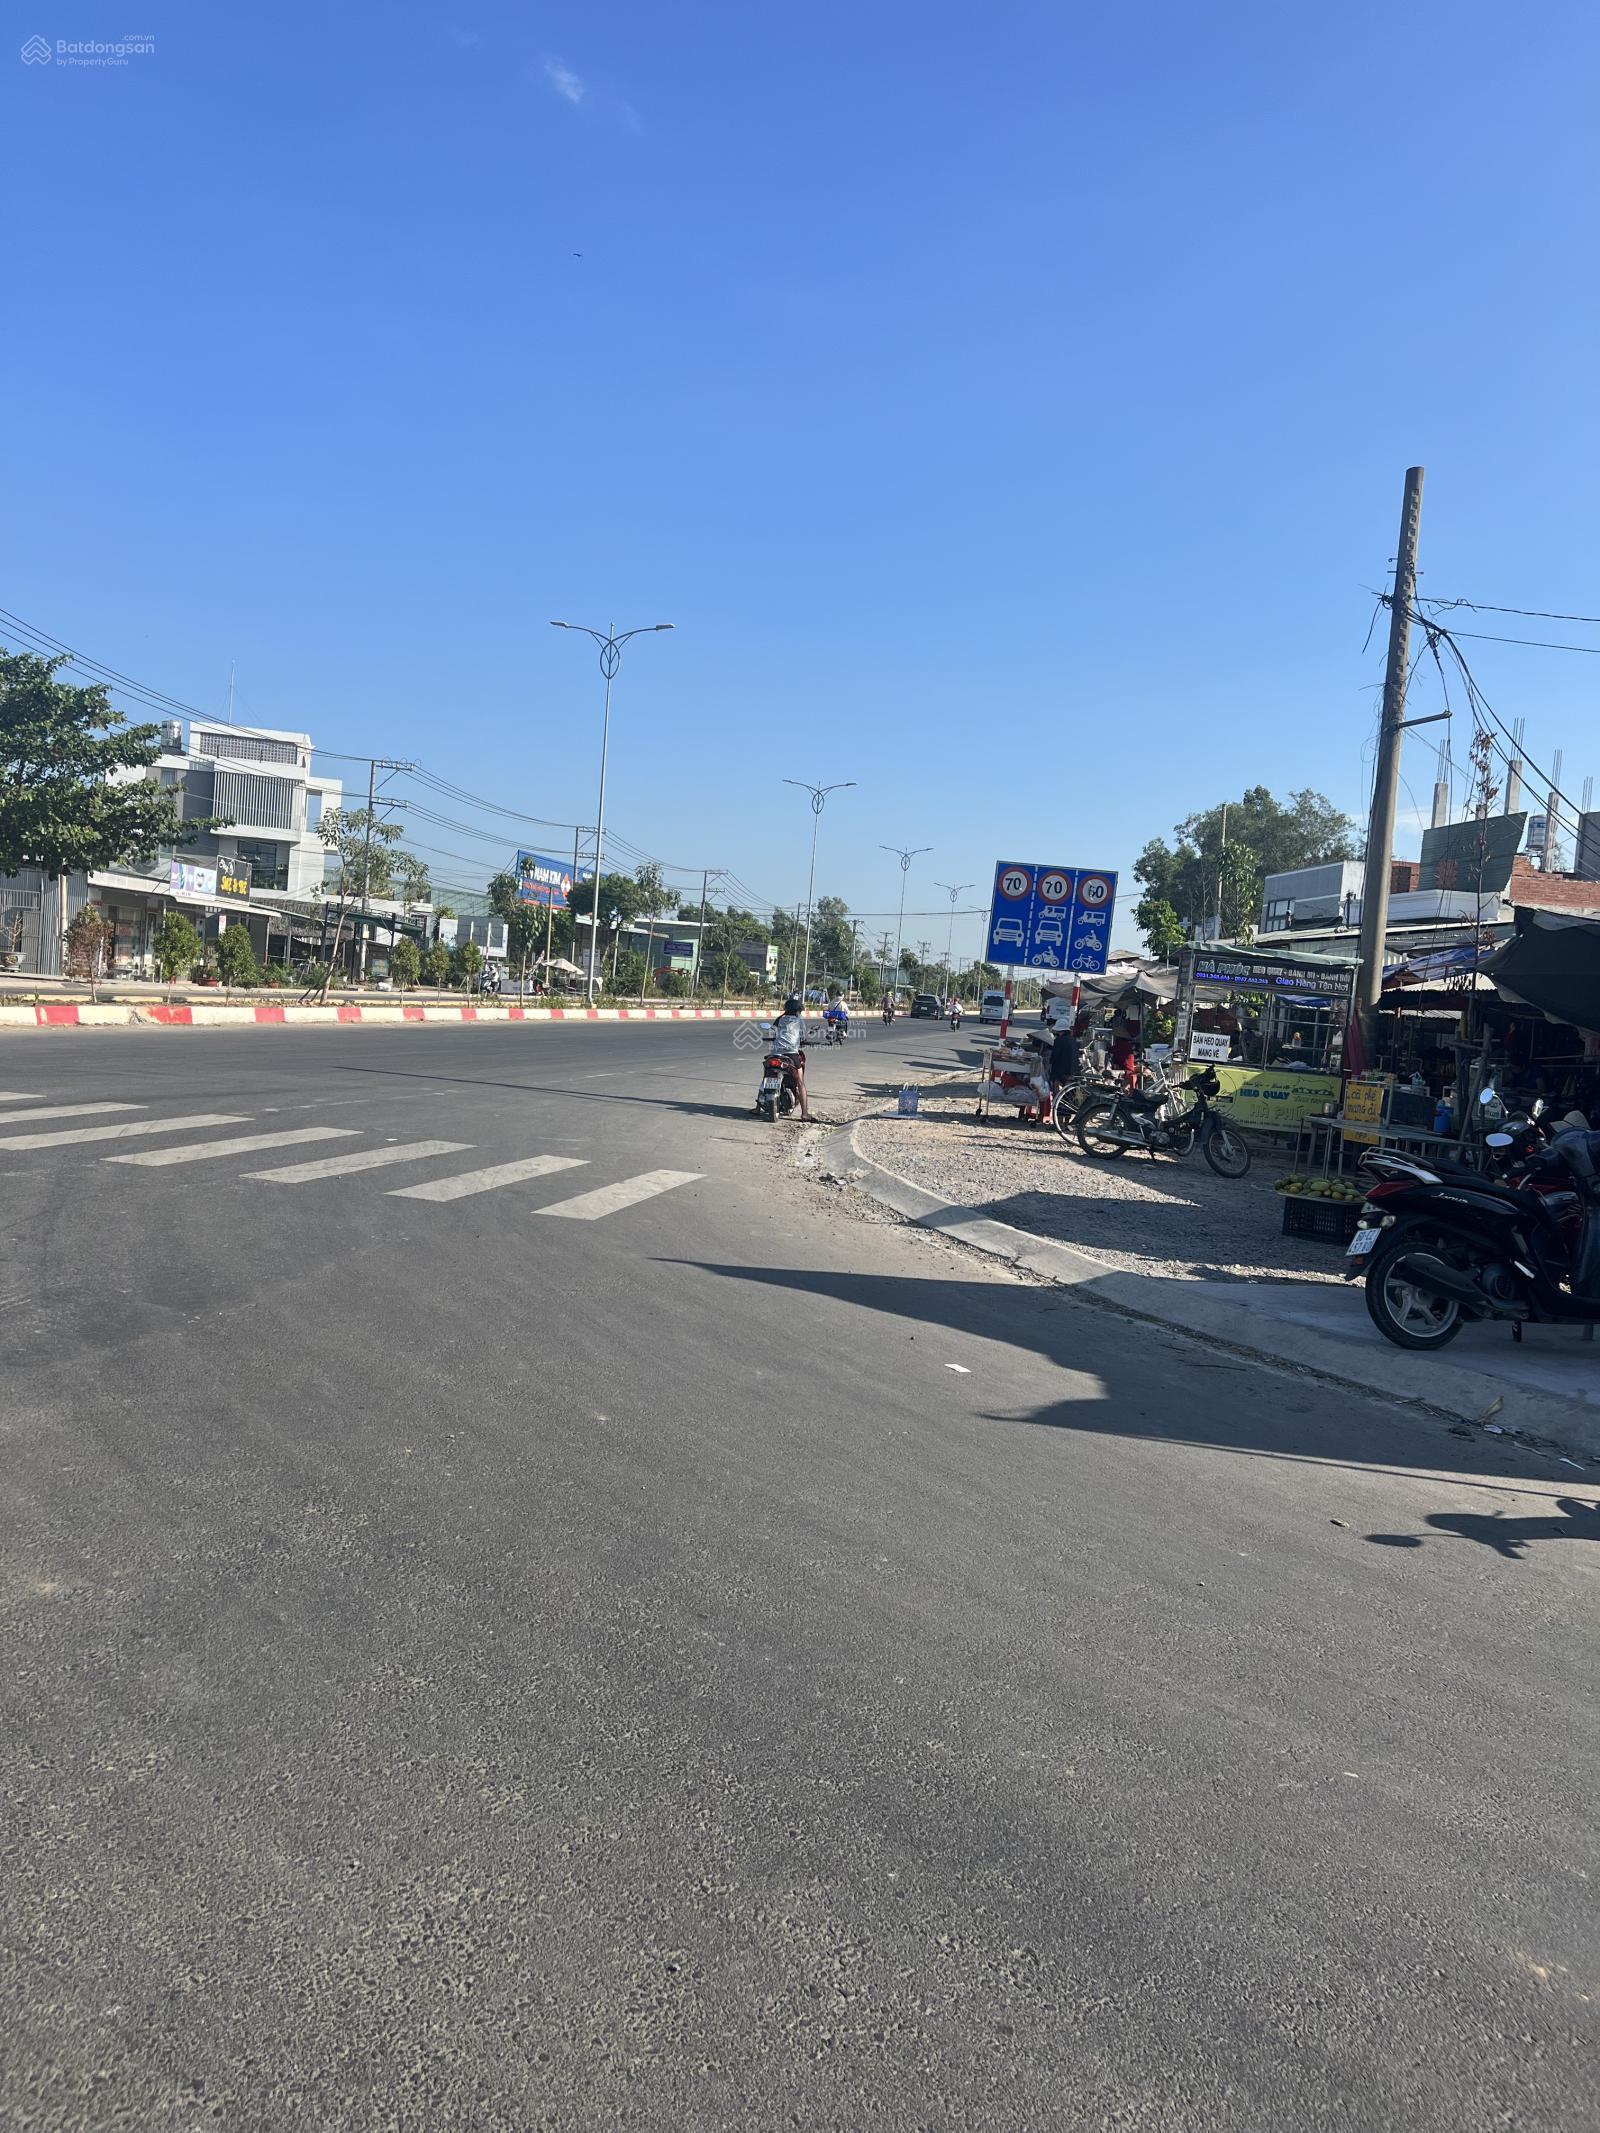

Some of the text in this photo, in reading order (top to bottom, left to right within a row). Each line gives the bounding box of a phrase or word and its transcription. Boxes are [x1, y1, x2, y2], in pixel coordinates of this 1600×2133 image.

[534, 866, 549, 882] NAM
[550, 870, 561, 885] KIM
[1005, 877, 1022, 891] 70
[1045, 881, 1063, 894] 70
[1217, 963, 1250, 976] PHÚC
[1275, 976, 1294, 986] Giao
[1295, 978, 1316, 990] Hàng
[1204, 1036, 1214, 1046] HEO
[1215, 1037, 1229, 1047] QUAY
[1198, 1048, 1212, 1057] MANG
[1240, 1088, 1260, 1098] HEO
[1263, 1090, 1290, 1100] QUAY
[1431, 1192, 1469, 1204] Janus
